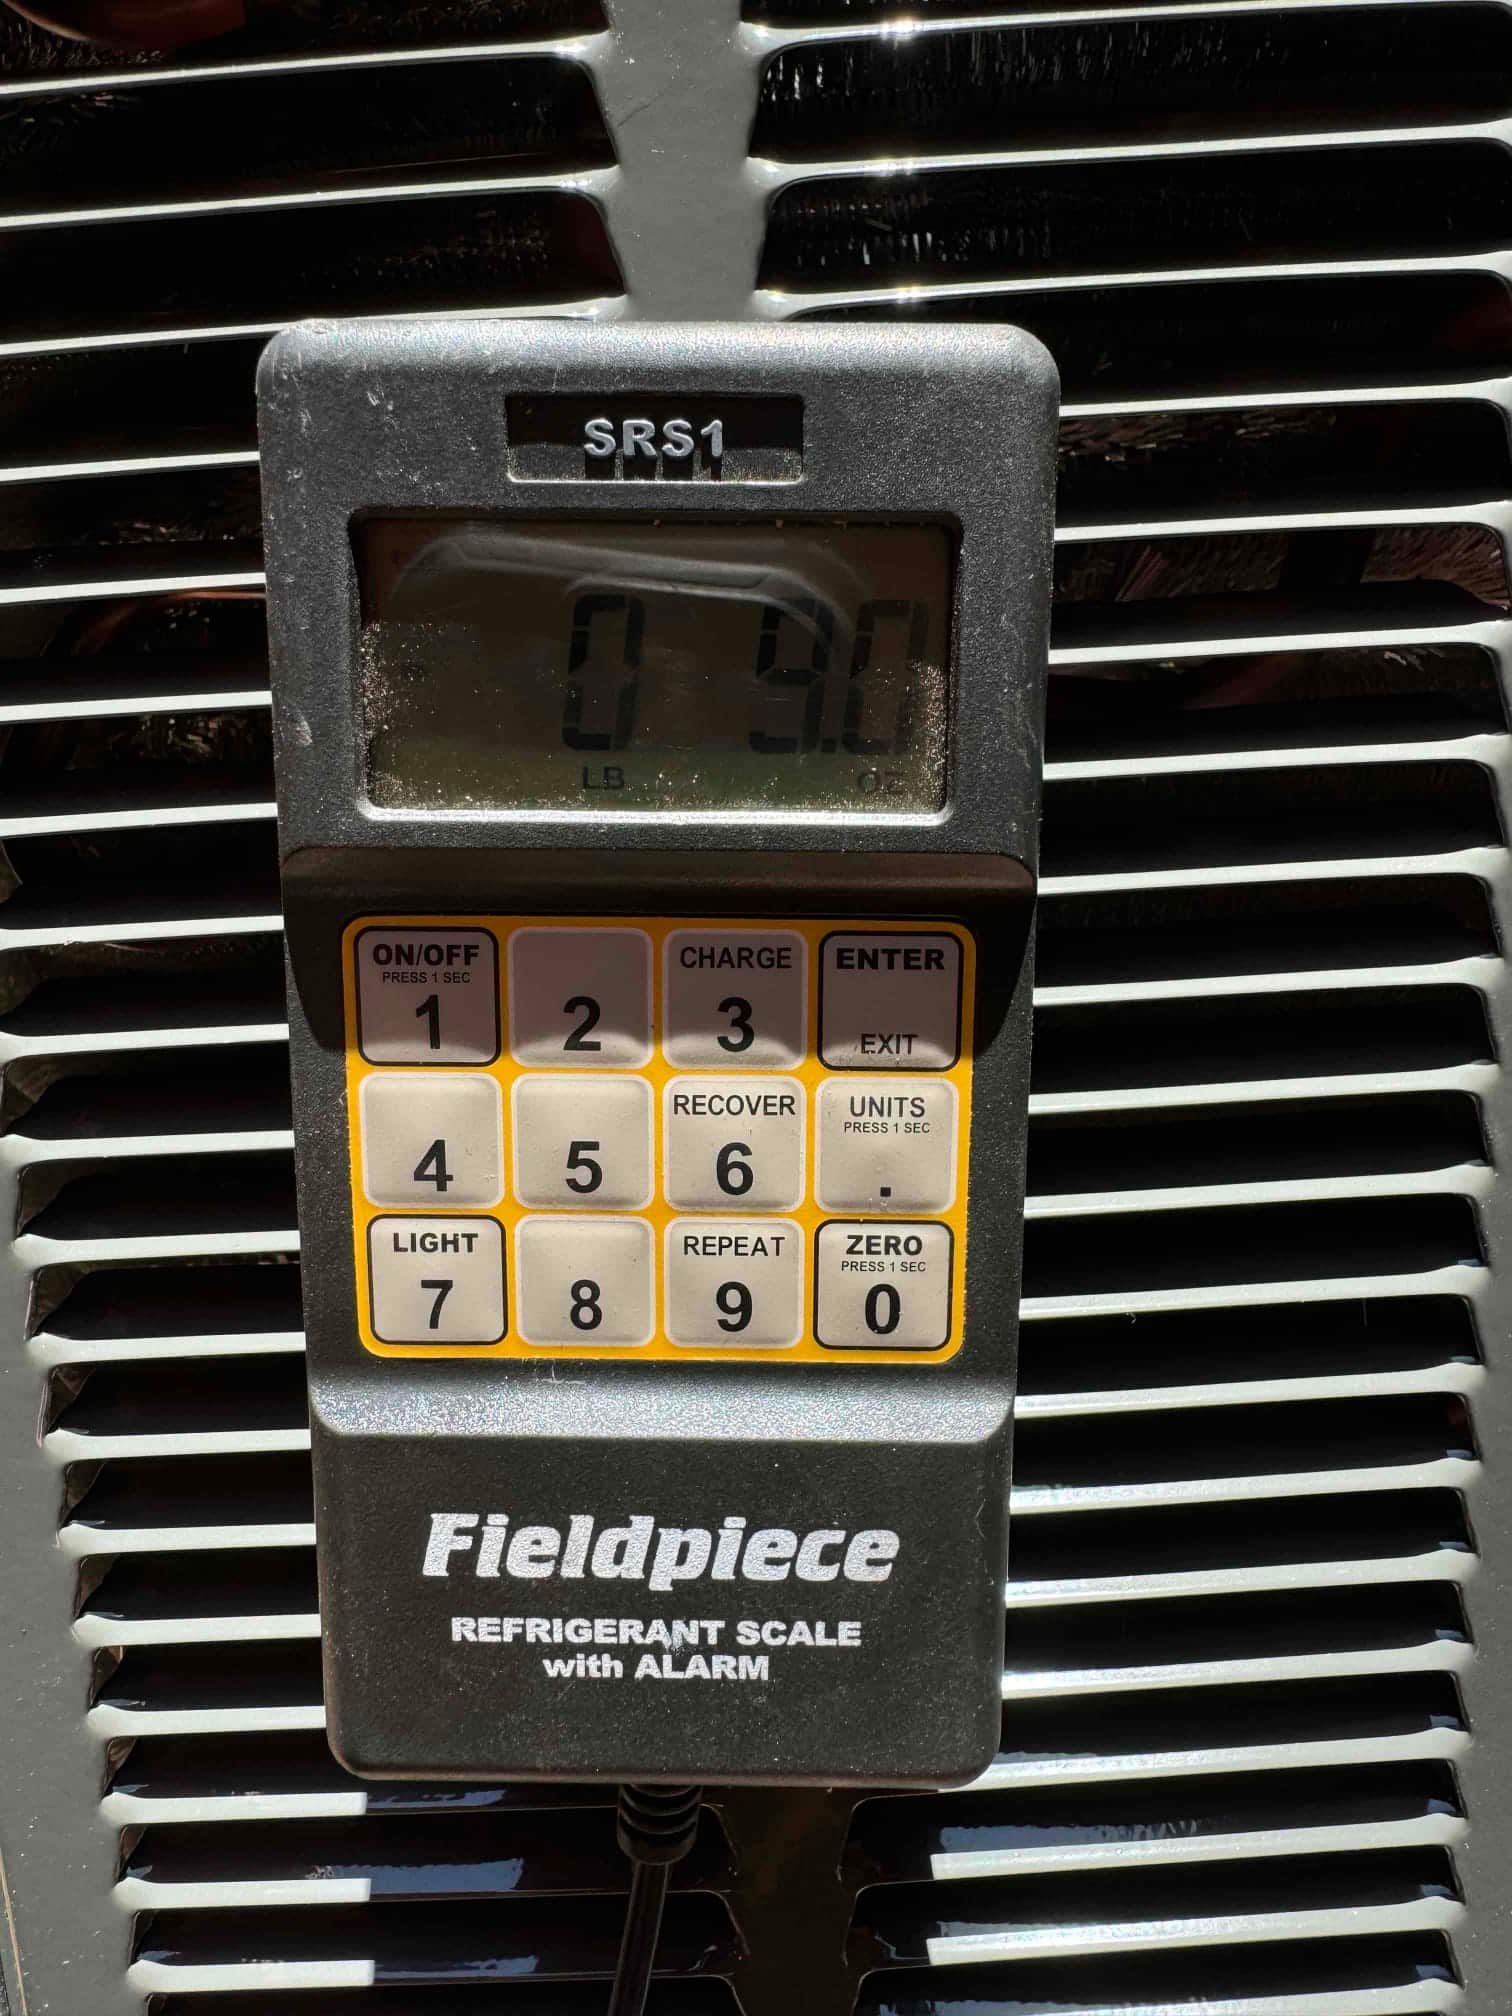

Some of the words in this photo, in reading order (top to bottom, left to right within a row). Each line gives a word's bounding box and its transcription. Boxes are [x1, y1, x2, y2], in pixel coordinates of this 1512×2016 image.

[583, 419, 725, 457] SRS1
[561, 594, 645, 751] 0
[583, 768, 625, 790] LB
[372, 944, 479, 966] ON/OFF
[679, 946, 792, 970] CHARGE
[836, 949, 945, 970] ENTER
[382, 971, 428, 984] PRESS
[434, 972, 439, 983] 1
[445, 971, 470, 984] SEC
[415, 994, 442, 1050] 1
[564, 996, 601, 1051] 2
[717, 996, 755, 1052] 3
[861, 1034, 918, 1054] EXIT
[673, 1095, 795, 1116] RECOVER
[849, 1096, 926, 1118] UNITS
[844, 1122, 889, 1134] PRESS
[893, 1123, 898, 1134] 1
[904, 1122, 930, 1134] SEC
[414, 1140, 454, 1192] 4
[566, 1141, 602, 1193] 5
[716, 1142, 754, 1195] 6
[393, 1232, 479, 1254] LIGHT
[684, 1236, 785, 1258] REPEAT
[846, 1235, 923, 1256] ZERO
[842, 1261, 885, 1272] PRESS
[890, 1261, 895, 1272] 1
[901, 1261, 926, 1272] SEC
[421, 1280, 454, 1329] 7
[570, 1280, 602, 1330] 8
[716, 1281, 753, 1332] 9
[865, 1284, 900, 1335] 0
[422, 1513, 900, 1591] Fieldpiece
[451, 1617, 725, 1647] REFRIGERANT
[737, 1621, 862, 1647] SCALE
[542, 1654, 623, 1679] with
[635, 1655, 768, 1681] ALARM
